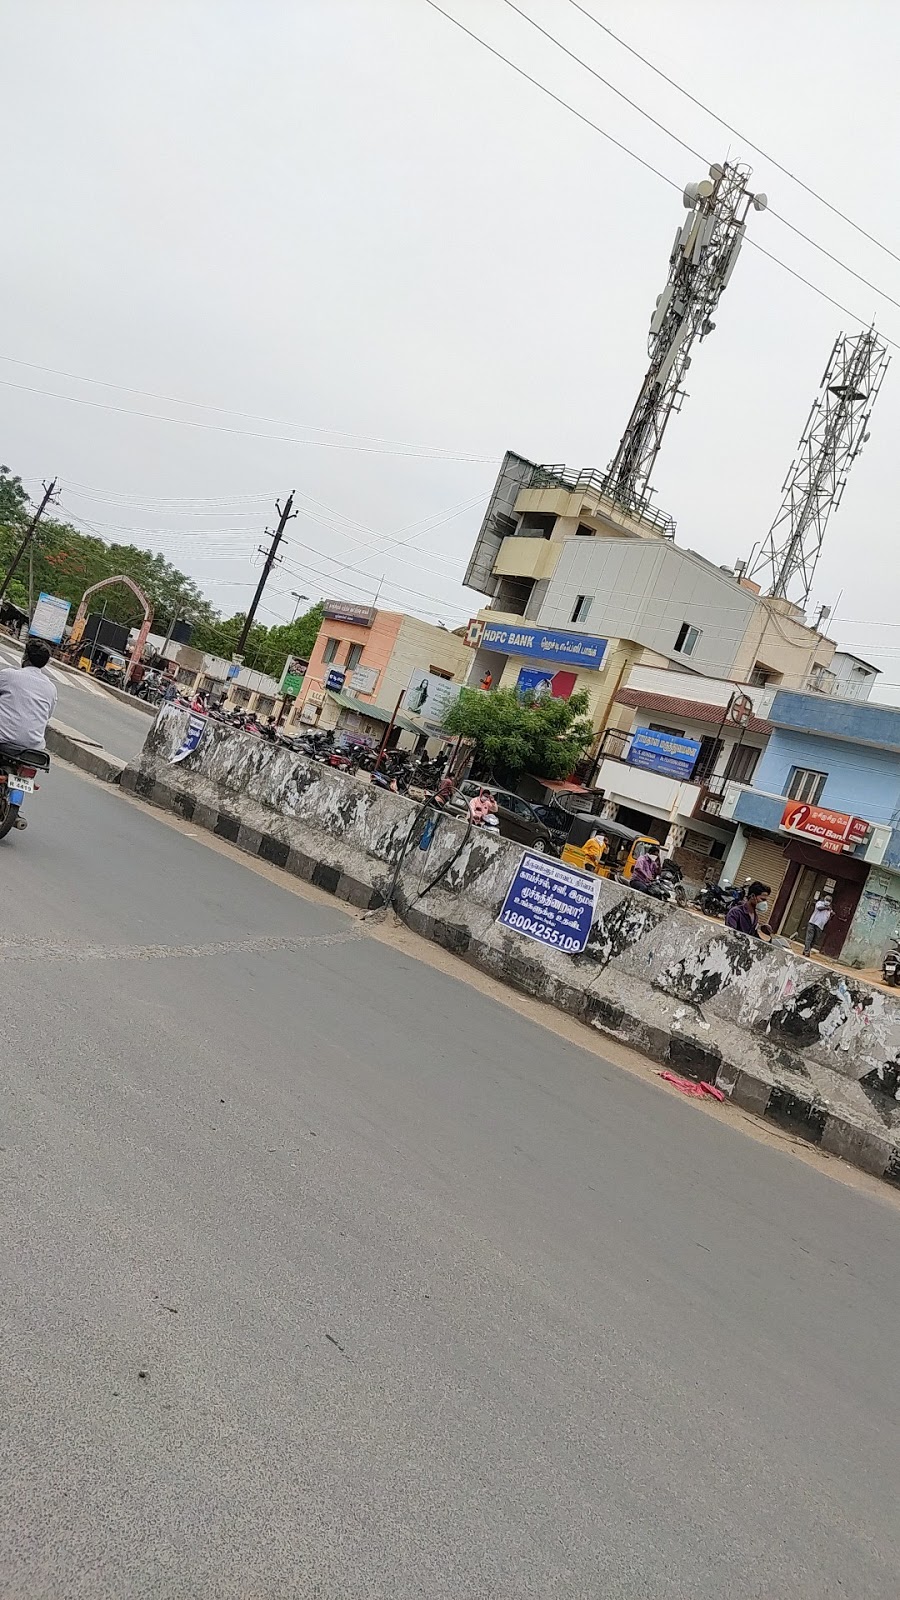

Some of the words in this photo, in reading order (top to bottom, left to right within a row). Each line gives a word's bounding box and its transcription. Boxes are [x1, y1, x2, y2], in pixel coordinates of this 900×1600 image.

[483, 629, 507, 644] HDFC
[508, 632, 535, 648] BANK
[804, 823, 826, 835] ICICI
[825, 830, 844, 841] Ban
[853, 823, 867, 832] ATM
[823, 841, 840, 852] ATM
[504, 910, 581, 951] 18004255109
